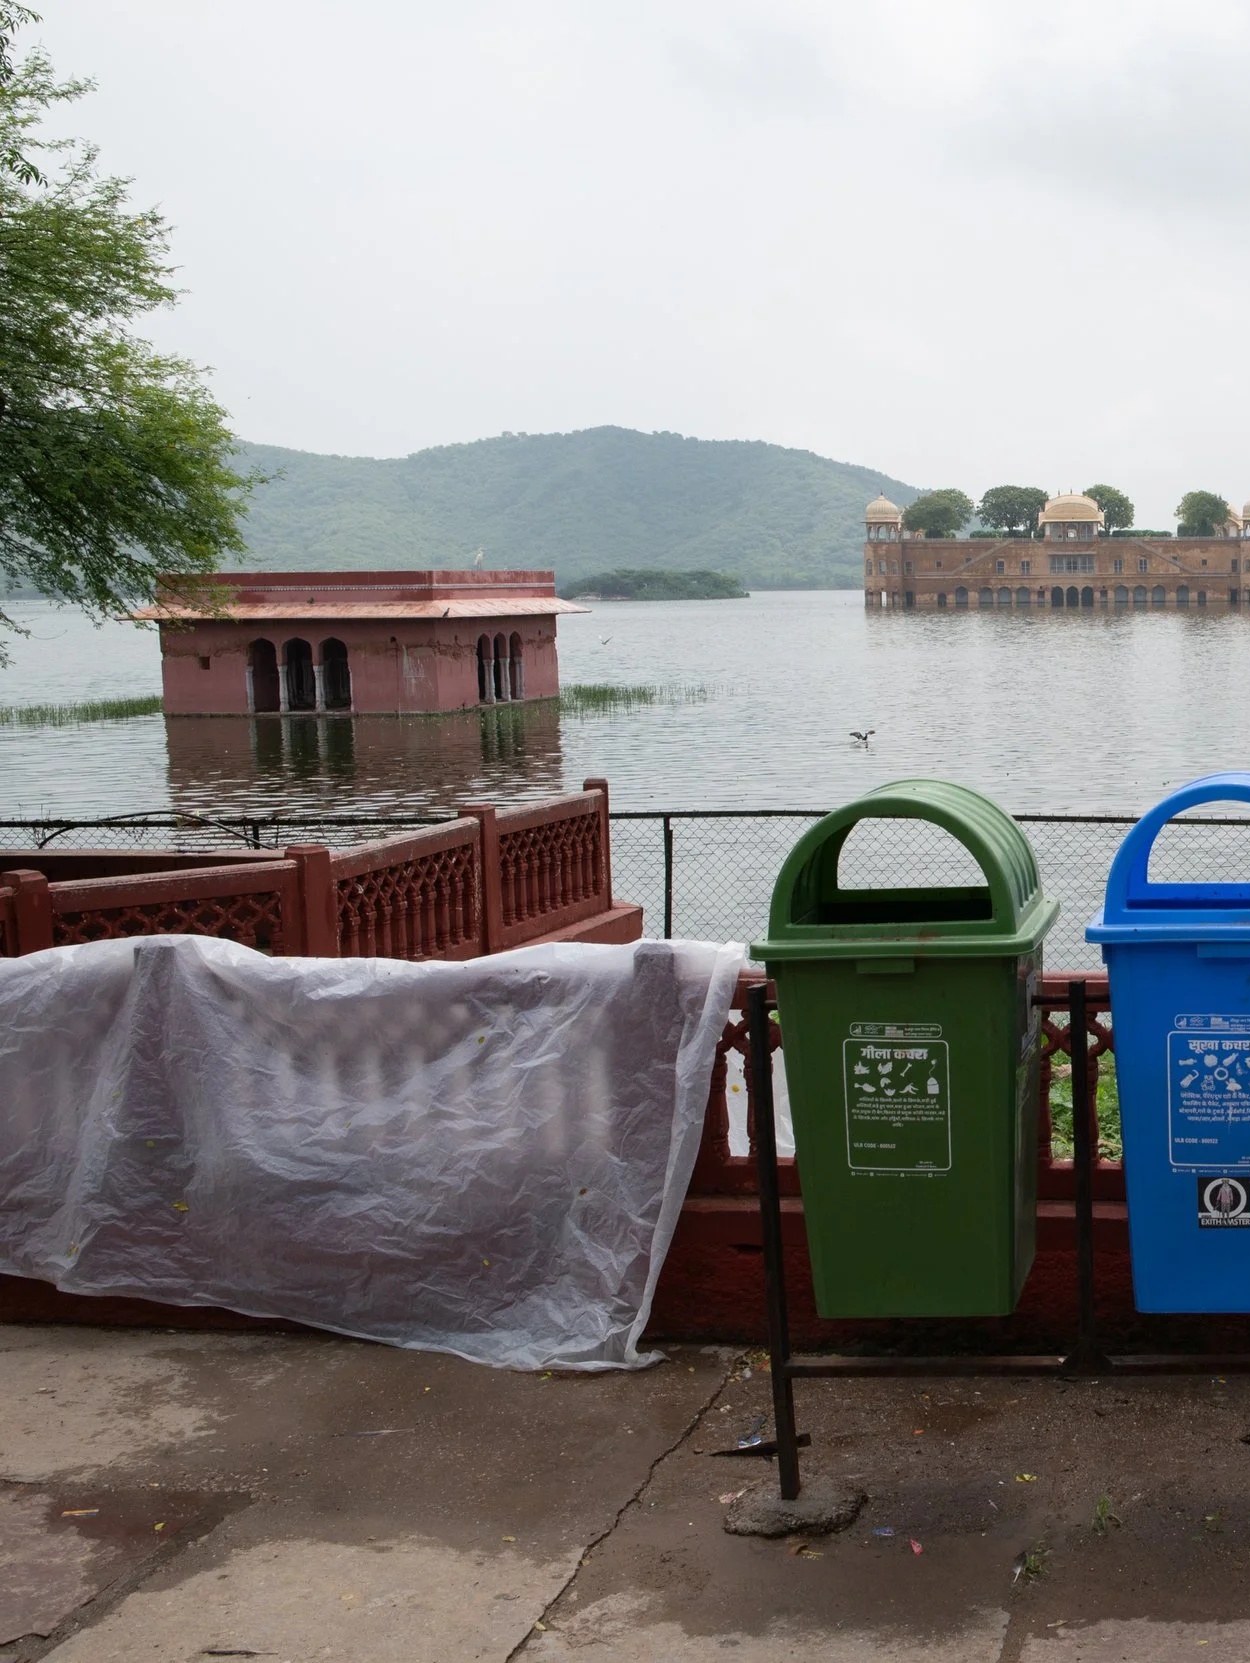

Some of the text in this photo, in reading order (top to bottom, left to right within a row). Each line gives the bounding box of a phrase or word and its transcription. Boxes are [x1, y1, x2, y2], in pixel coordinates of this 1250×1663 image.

[860, 1045, 929, 1060] गीला कचरा
[1188, 1040, 1220, 1054] सूखा
